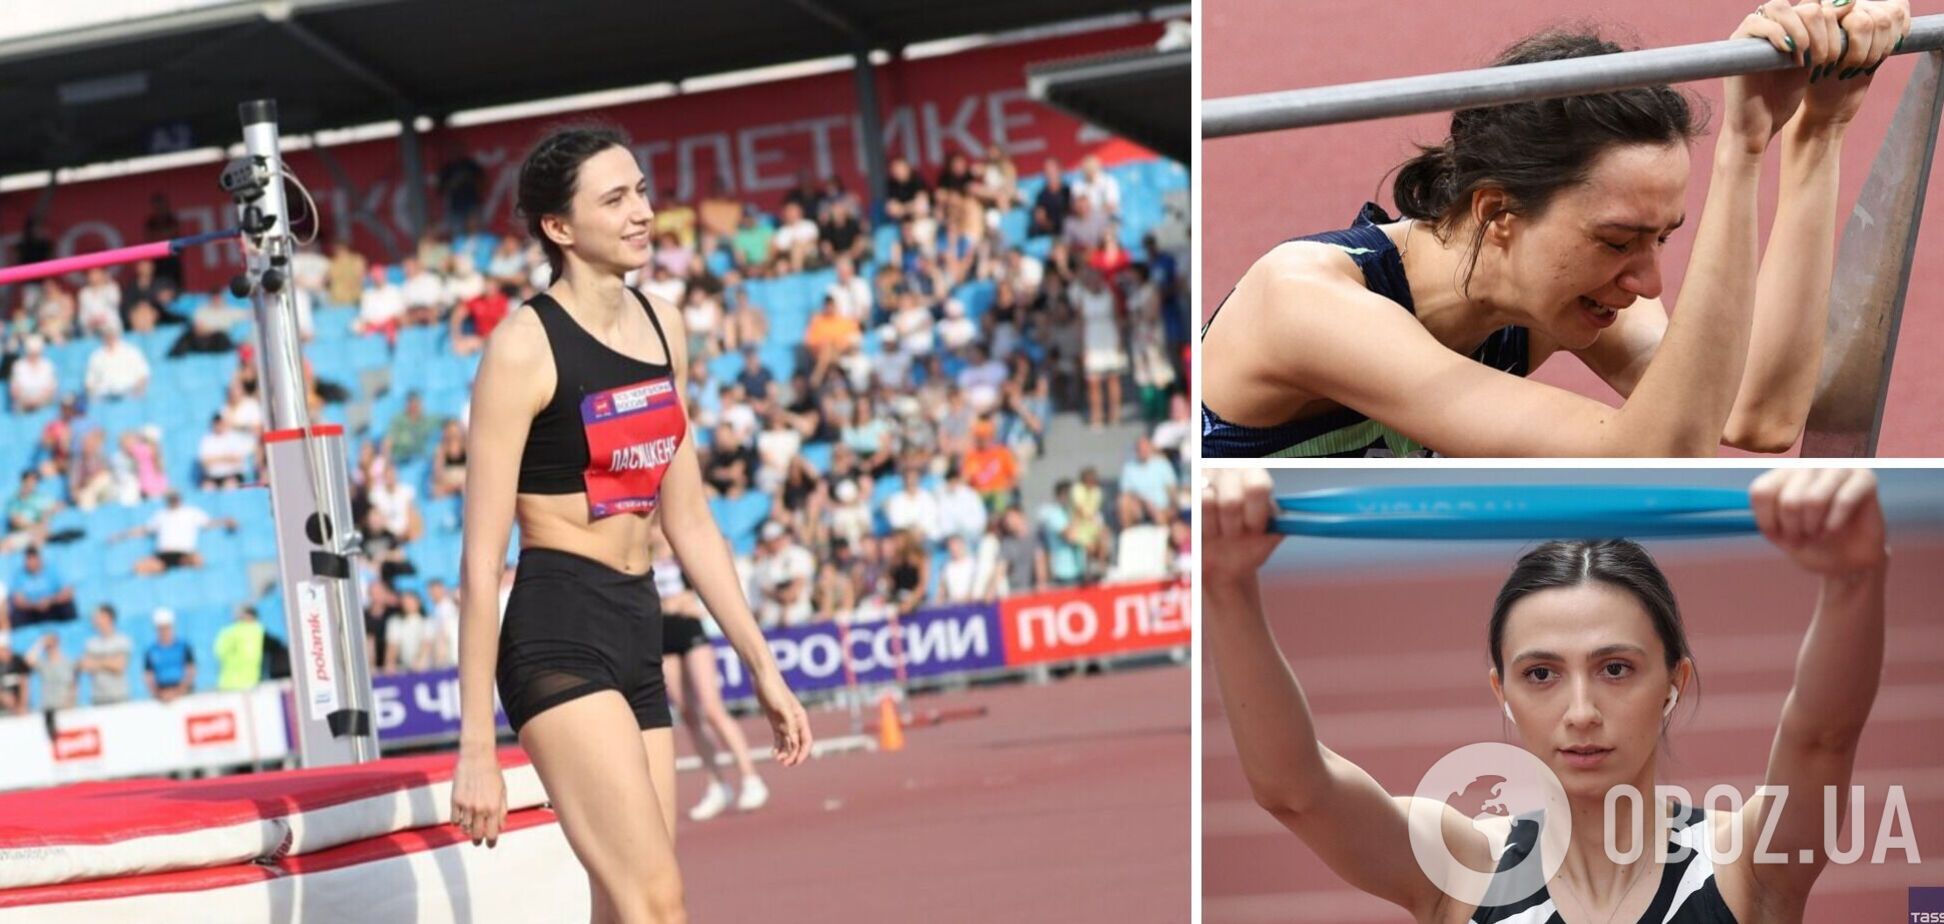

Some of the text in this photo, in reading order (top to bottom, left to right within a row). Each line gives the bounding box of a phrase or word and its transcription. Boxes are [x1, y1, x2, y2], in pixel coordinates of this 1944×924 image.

[632, 88, 1047, 203] ТЛЕТИКЕ
[307, 611, 331, 682] polanik
[768, 614, 989, 678] РОССИИ
[1016, 599, 1099, 651] ПО
